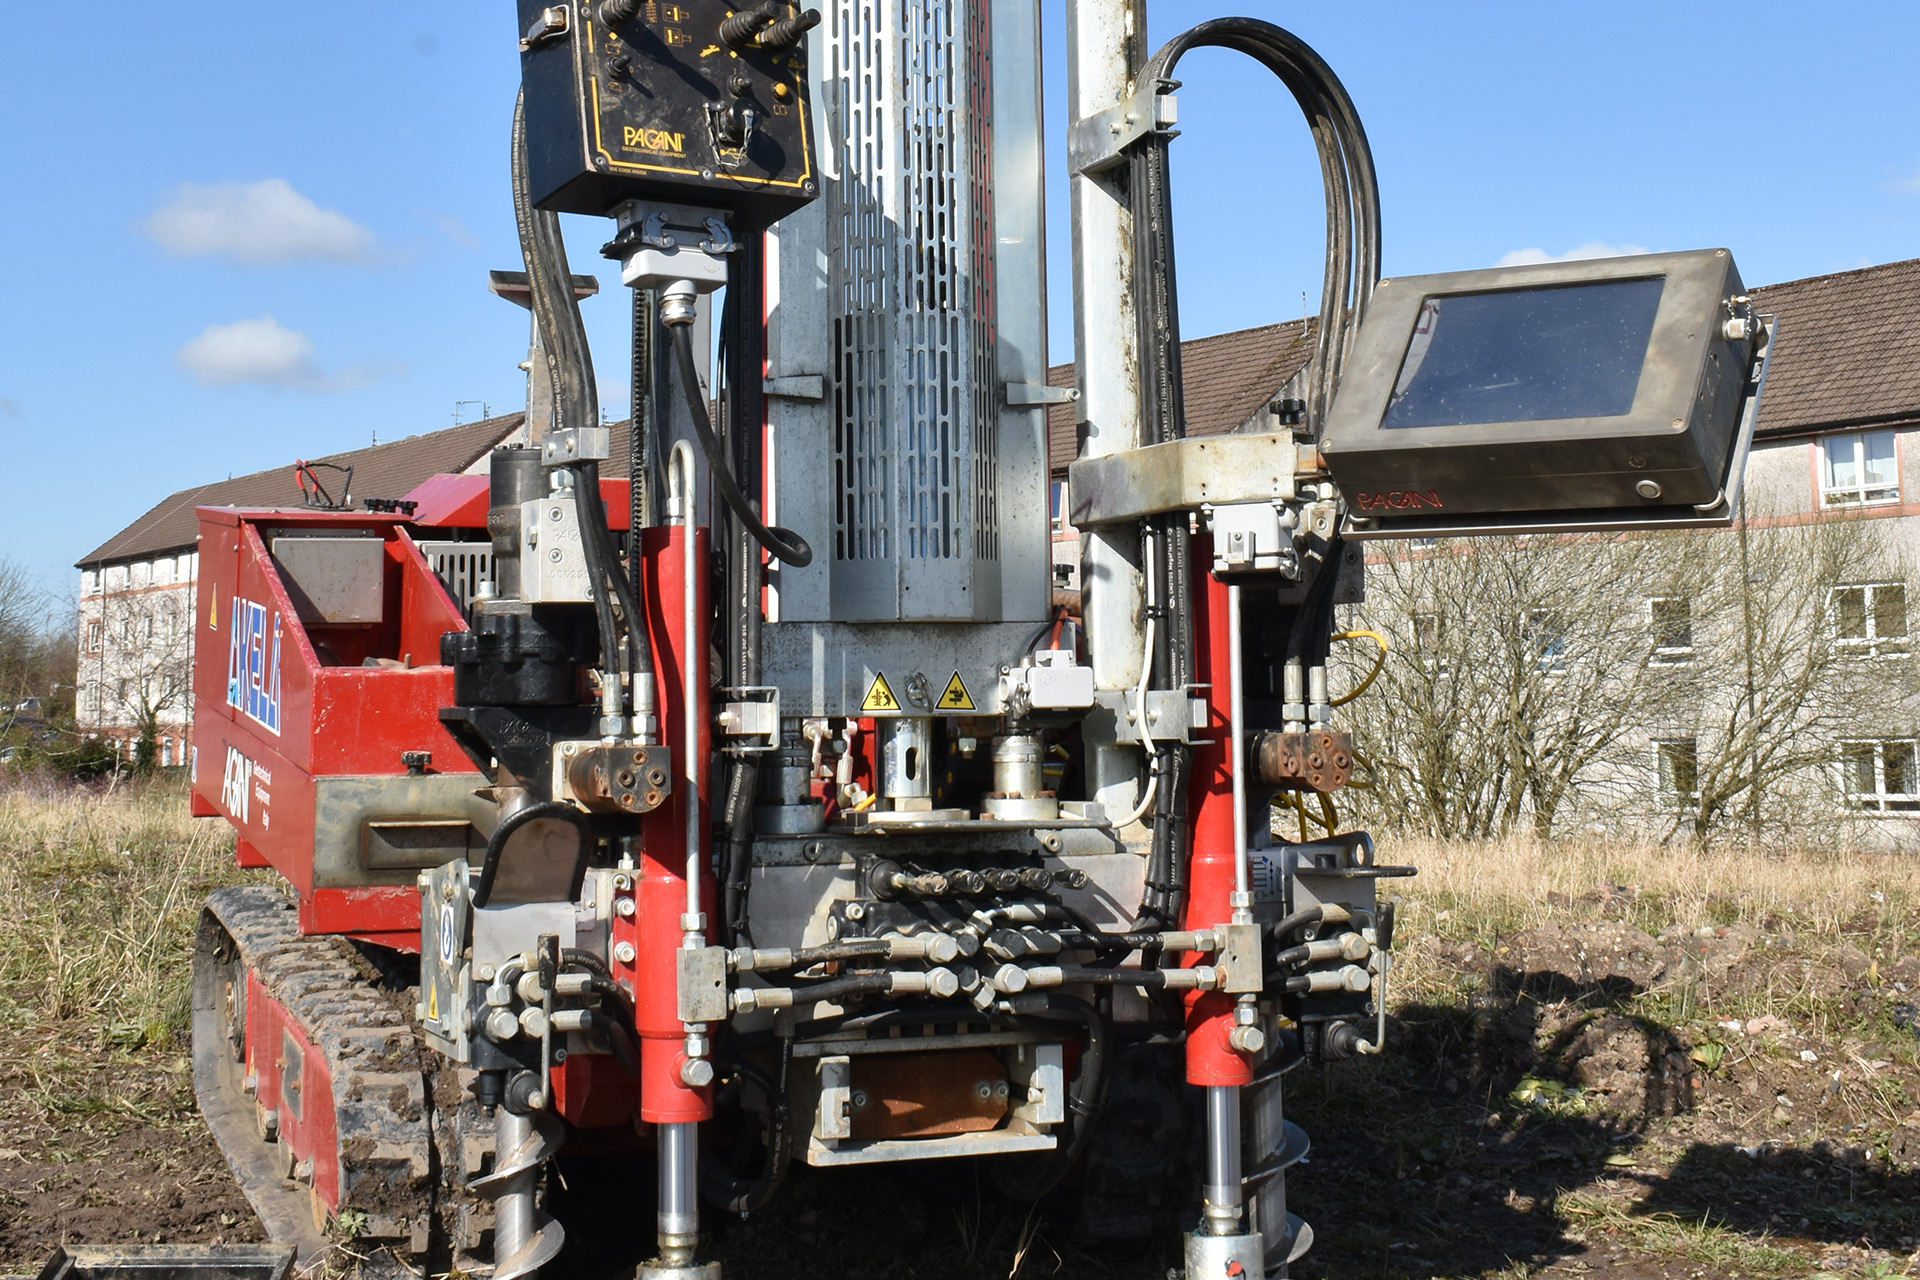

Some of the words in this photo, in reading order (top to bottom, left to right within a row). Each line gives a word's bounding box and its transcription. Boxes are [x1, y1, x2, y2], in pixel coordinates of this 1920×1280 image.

[621, 145, 658, 155] GEOTECHNICAL
[659, 150, 687, 158] EQUIPMENT
[1357, 490, 1443, 510] PAGANI
[226, 595, 281, 737] AKELA
